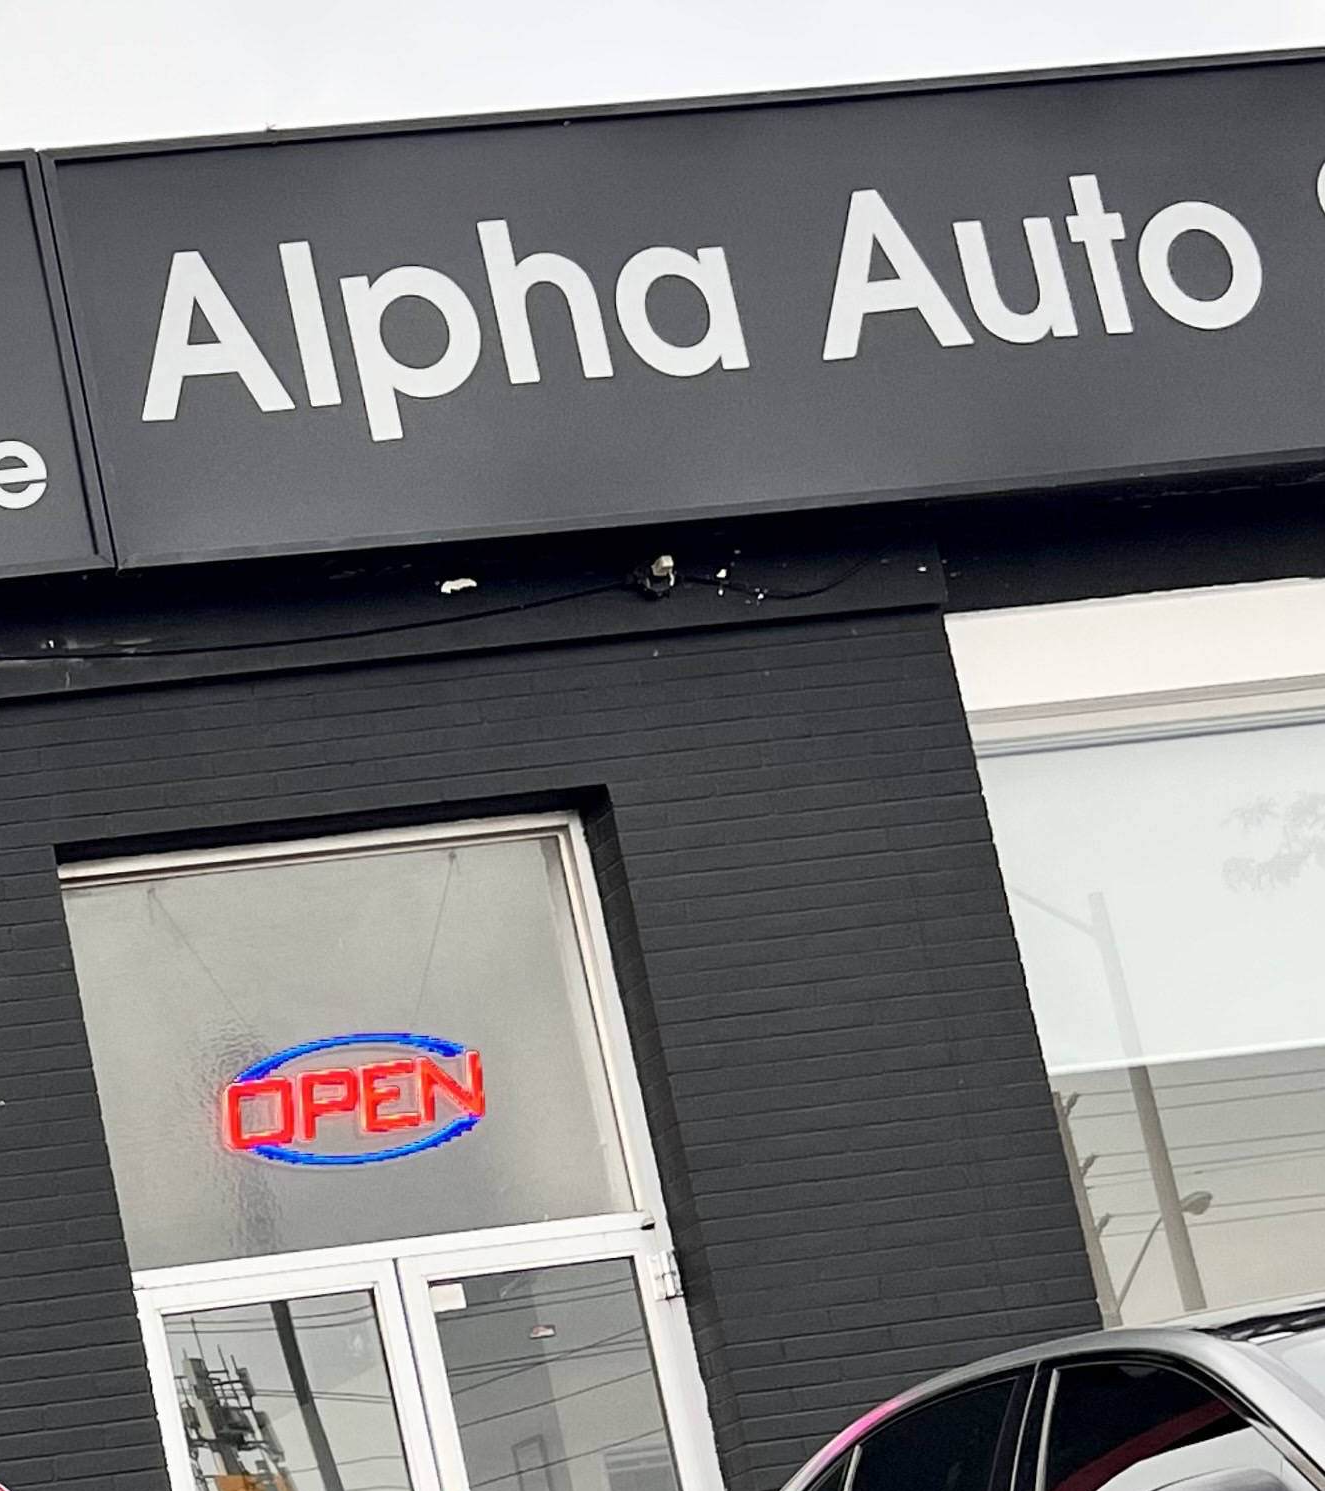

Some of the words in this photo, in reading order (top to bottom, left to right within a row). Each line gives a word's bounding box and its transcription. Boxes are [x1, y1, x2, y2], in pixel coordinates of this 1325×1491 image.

[141, 218, 750, 442] Alpha
[822, 173, 1263, 361] Auto
[223, 1050, 486, 1152] OPEN
